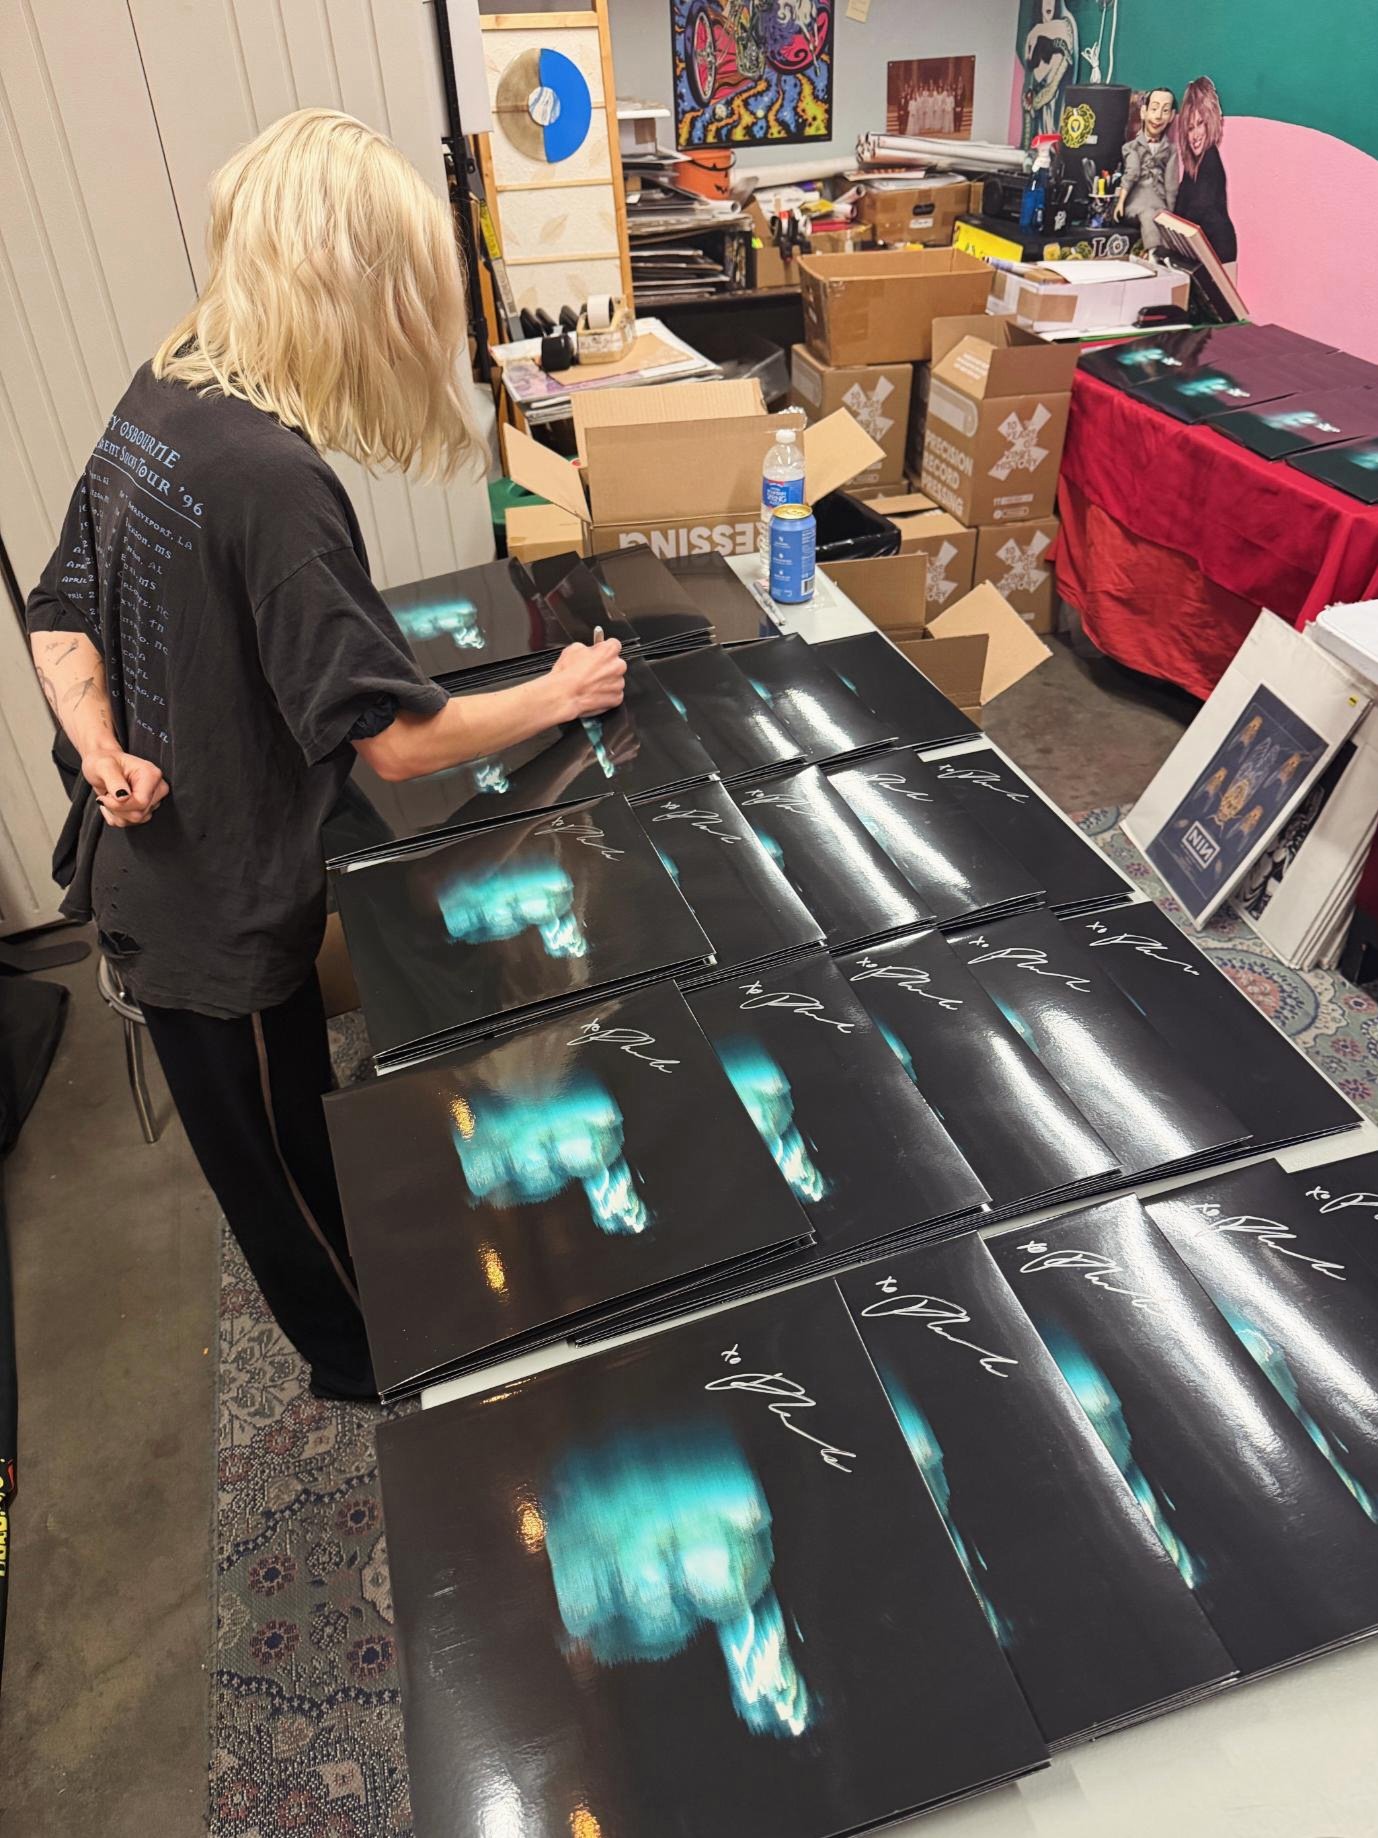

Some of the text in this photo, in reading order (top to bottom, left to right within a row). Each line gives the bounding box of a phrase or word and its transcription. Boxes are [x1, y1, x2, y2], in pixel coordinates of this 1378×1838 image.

[923, 449, 960, 491] RECORD
[924, 429, 974, 477] PRECISION
[921, 471, 964, 517] PRESSING
